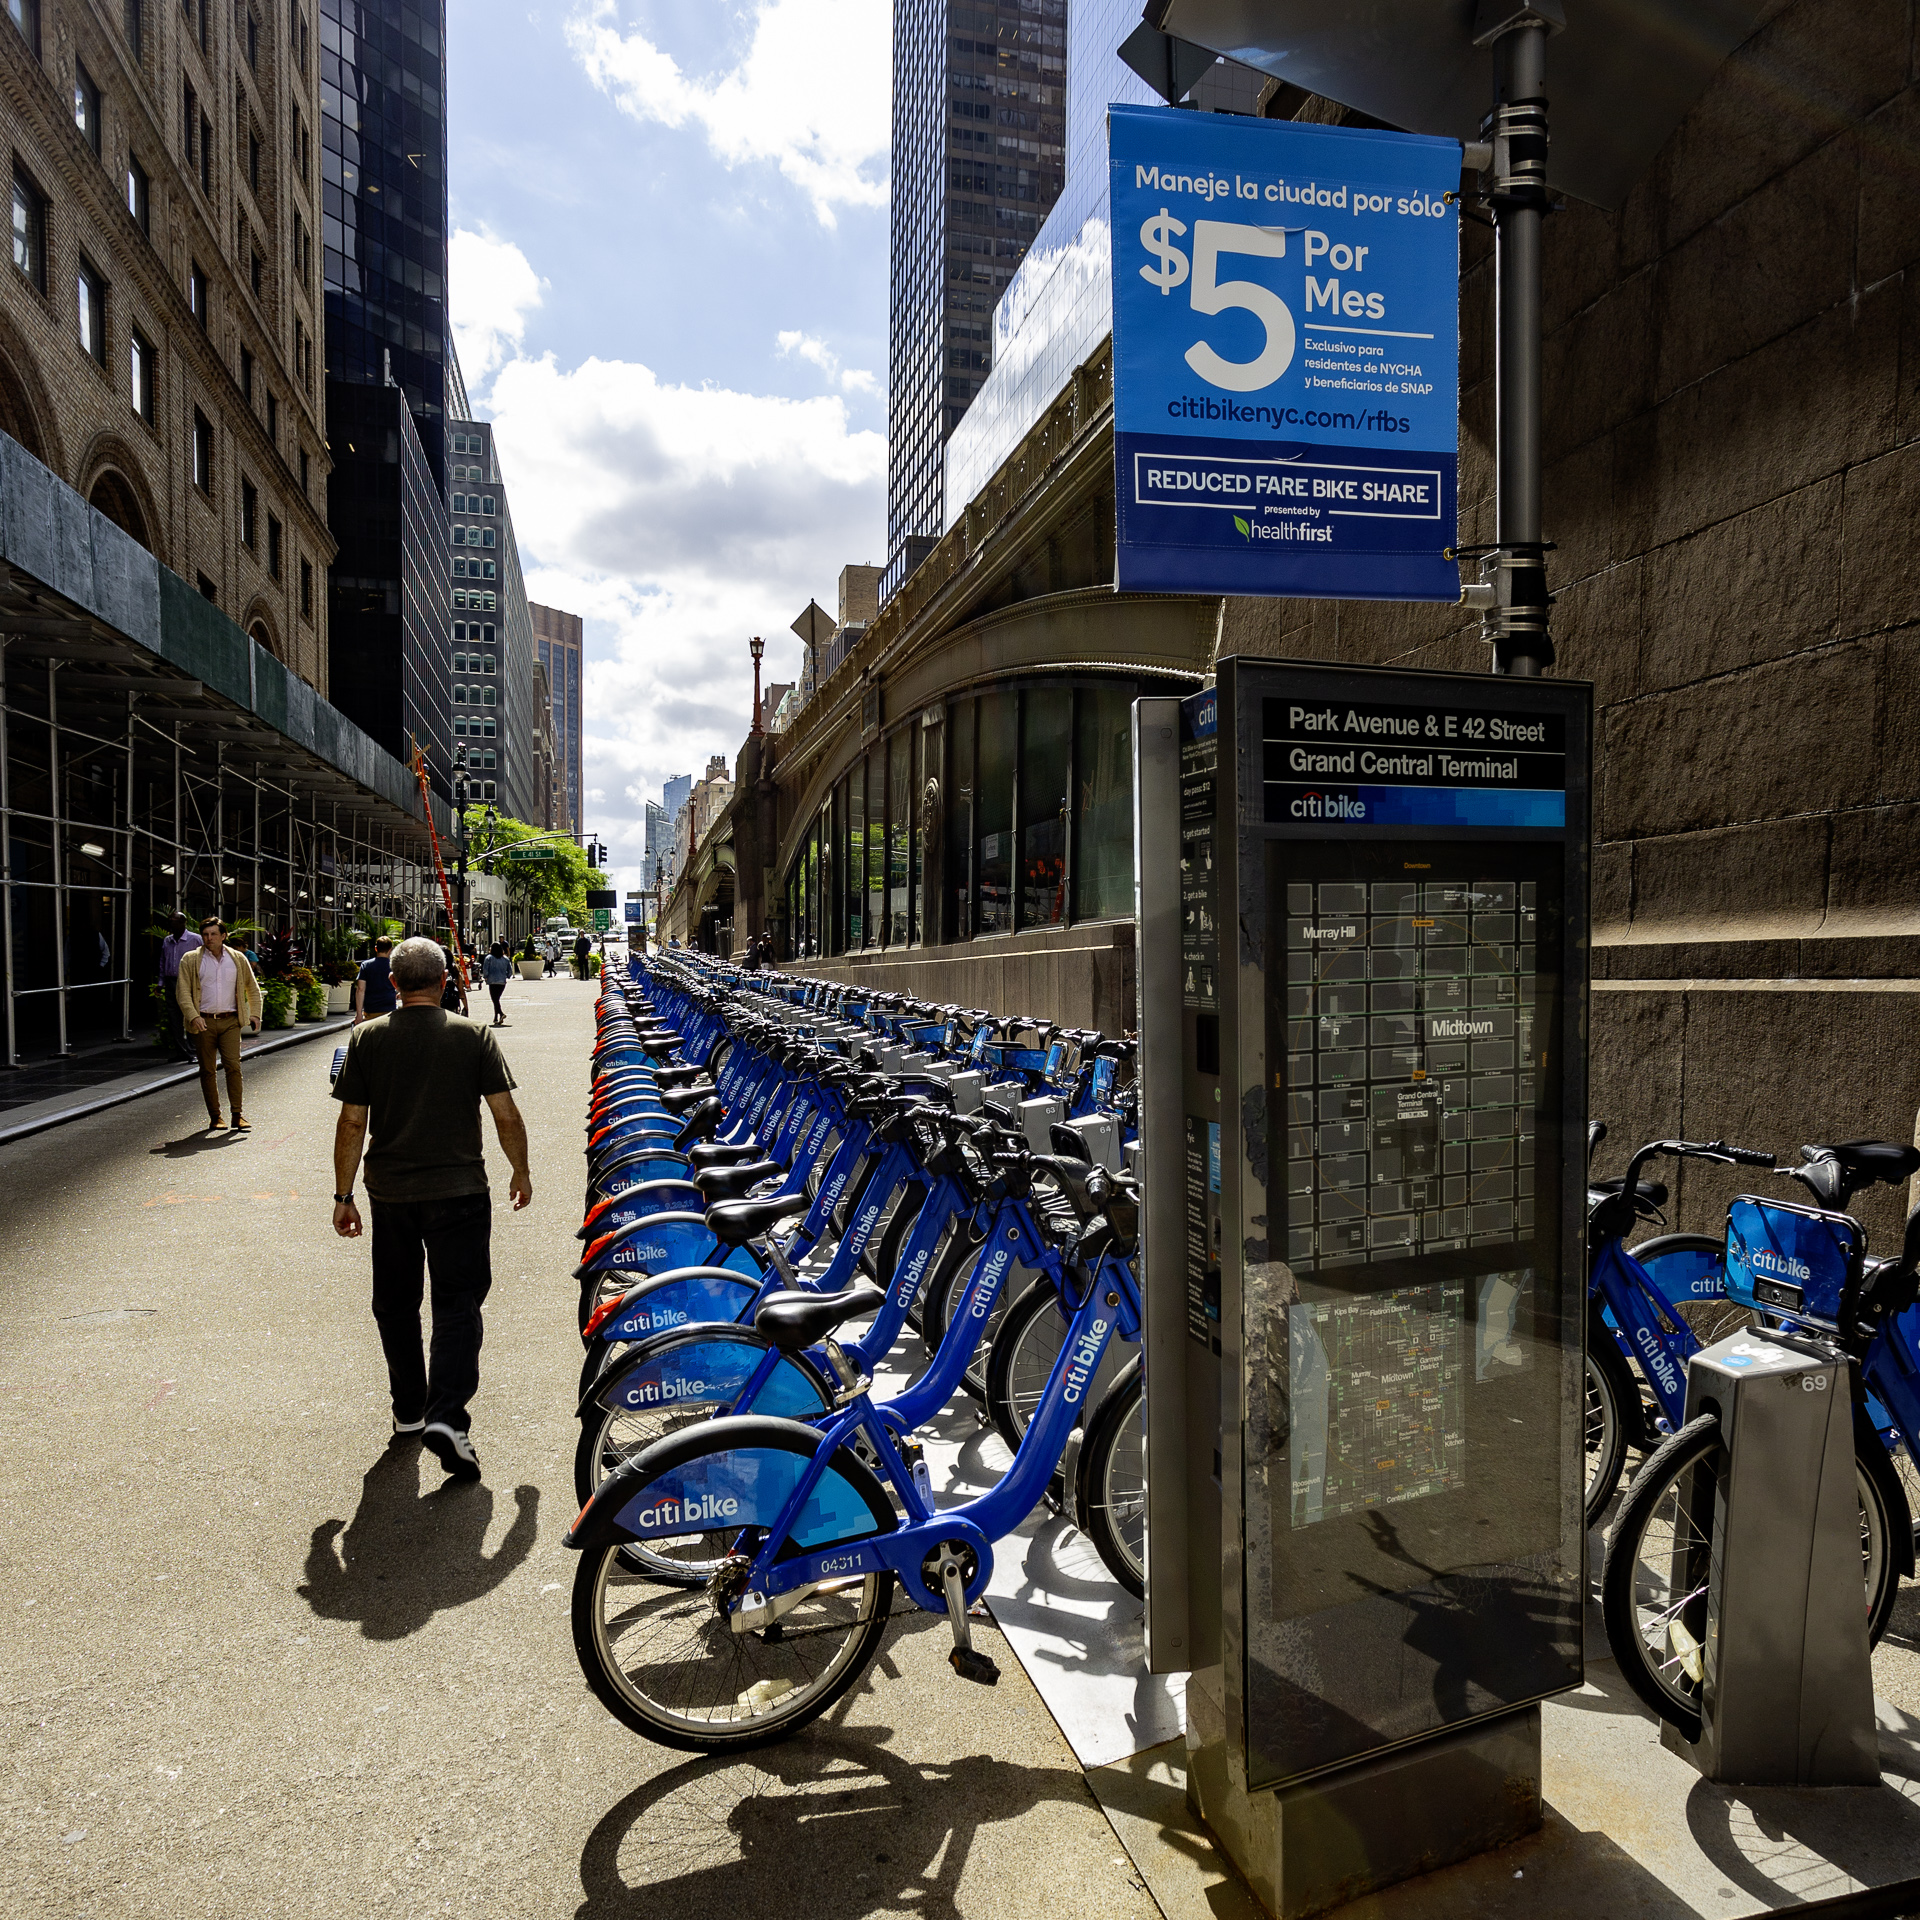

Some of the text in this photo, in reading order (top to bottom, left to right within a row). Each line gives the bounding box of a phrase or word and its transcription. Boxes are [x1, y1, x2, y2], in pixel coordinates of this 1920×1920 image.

[1136, 165, 1446, 218] Maneje la ciudad por sólo
[1304, 229, 1369, 272] Por
[1139, 208, 1296, 393] $5
[1304, 275, 1386, 320] Mes
[1304, 338, 1384, 358] Exclusivo para
[1304, 357, 1422, 377] residentes de NYCHA
[1304, 376, 1433, 395] y beneficiarios de SNAP
[1167, 395, 1411, 433] citibikenyc.com/rfbs
[1147, 469, 1429, 504] REDUCED FARE BIKE SHARE
[1264, 504, 1320, 518] presented by
[1251, 520, 1333, 542] healthfirst
[1289, 707, 1545, 742] Park Avenue & E 42 Street
[1289, 748, 1518, 779] Grand Central Terminal
[1194, 825, 1210, 837] started
[1303, 926, 1355, 940] Murray Hill
[1432, 1020, 1493, 1037] Midtown
[1397, 1092, 1416, 1100] Grand
[1046, 1106, 1056, 1114] 63
[1397, 1099, 1423, 1108] Terminal
[1099, 1126, 1112, 1134] 64
[1443, 1288, 1464, 1296] Chelsea
[1369, 1304, 1411, 1316] Flatiron District
[1420, 1355, 1443, 1363] Garment
[1420, 1362, 1439, 1371] District
[1351, 1371, 1371, 1379] Murray
[1381, 1372, 1414, 1384] Midtown
[1802, 1375, 1827, 1392] 69
[1422, 1403, 1441, 1412] Square
[1445, 1432, 1458, 1440] Hell's
[1445, 1439, 1464, 1447] Kitchen
[1292, 1477, 1320, 1488] Roosevelt
[1292, 1486, 1309, 1495] Island
[1387, 1490, 1419, 1503] Central Park
